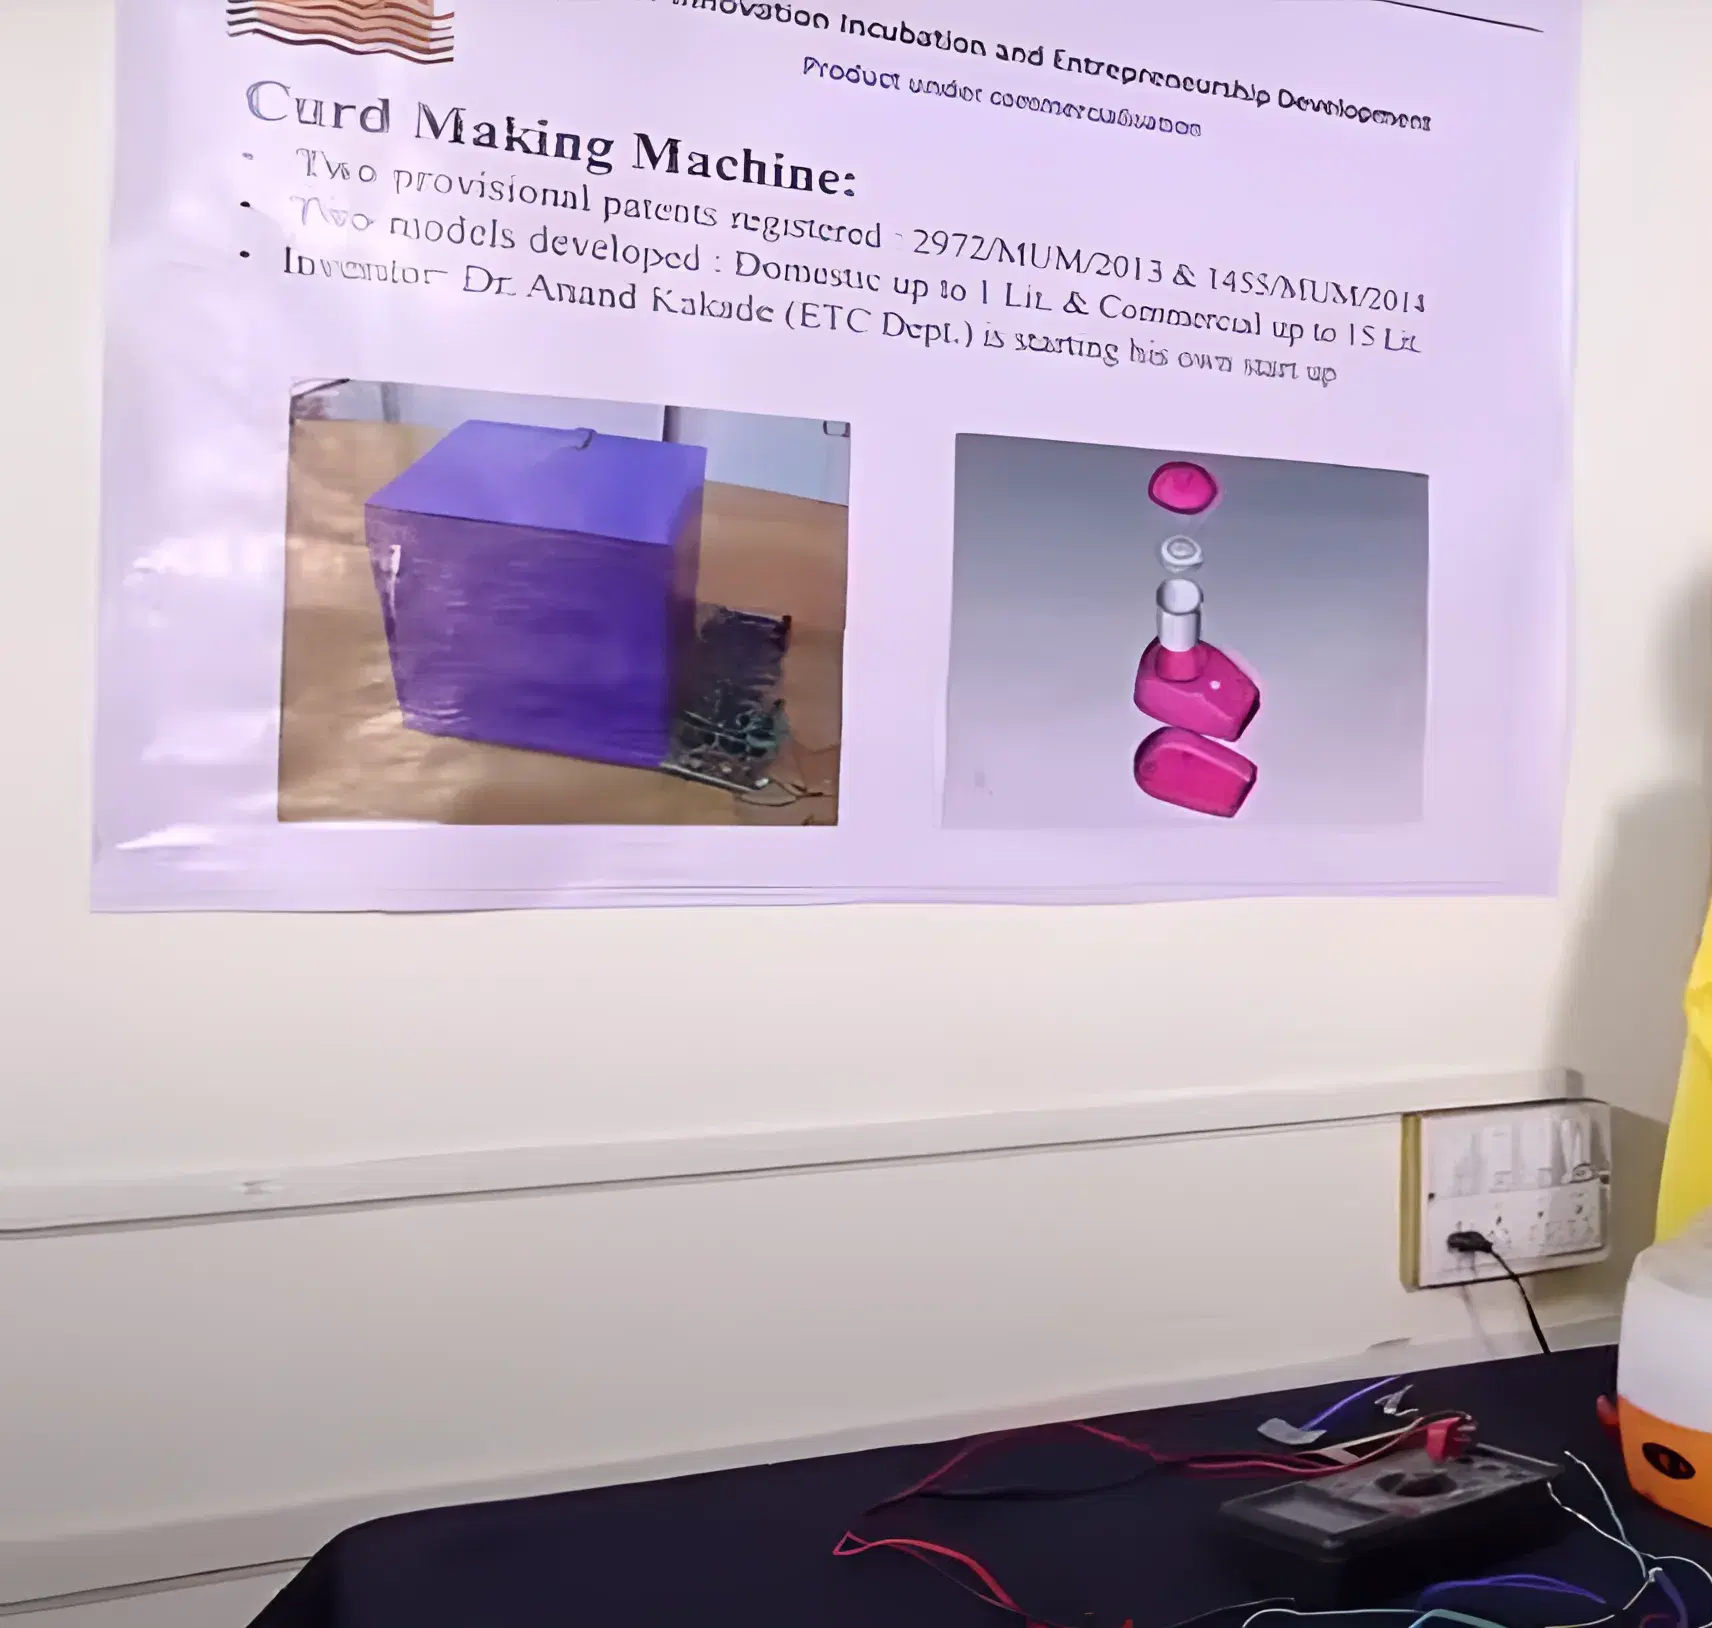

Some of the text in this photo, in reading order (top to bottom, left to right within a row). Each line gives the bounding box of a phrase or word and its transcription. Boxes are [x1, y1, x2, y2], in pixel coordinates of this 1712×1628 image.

[803, 56, 900, 90] Product
[840, 14, 986, 56] Incubation
[996, 44, 1044, 66] and
[246, 81, 856, 197] Curd Making Machine:
[289, 195, 375, 231] Two
[390, 215, 515, 248] models
[530, 225, 699, 273] developed
[894, 277, 928, 305] up
[941, 280, 966, 301] to
[1063, 291, 1089, 315] &
[1099, 294, 1260, 335] Commercial
[1273, 321, 1304, 347] up
[1314, 323, 1336, 342] to
[296, 148, 377, 182] Two
[393, 170, 591, 211] provisional
[604, 196, 717, 226] patents
[731, 212, 881, 248] registered
[914, 229, 1162, 282] 2972/MUM/2013
[1173, 264, 1196, 288] &
[526, 274, 636, 309] Anand
[785, 301, 871, 333] (ETC
[882, 312, 972, 348] Dept.)
[984, 323, 1004, 348] is
[1015, 333, 1119, 367] starting
[1130, 338, 1168, 366] his
[1178, 352, 1232, 372] own
[1307, 366, 1337, 388] up
